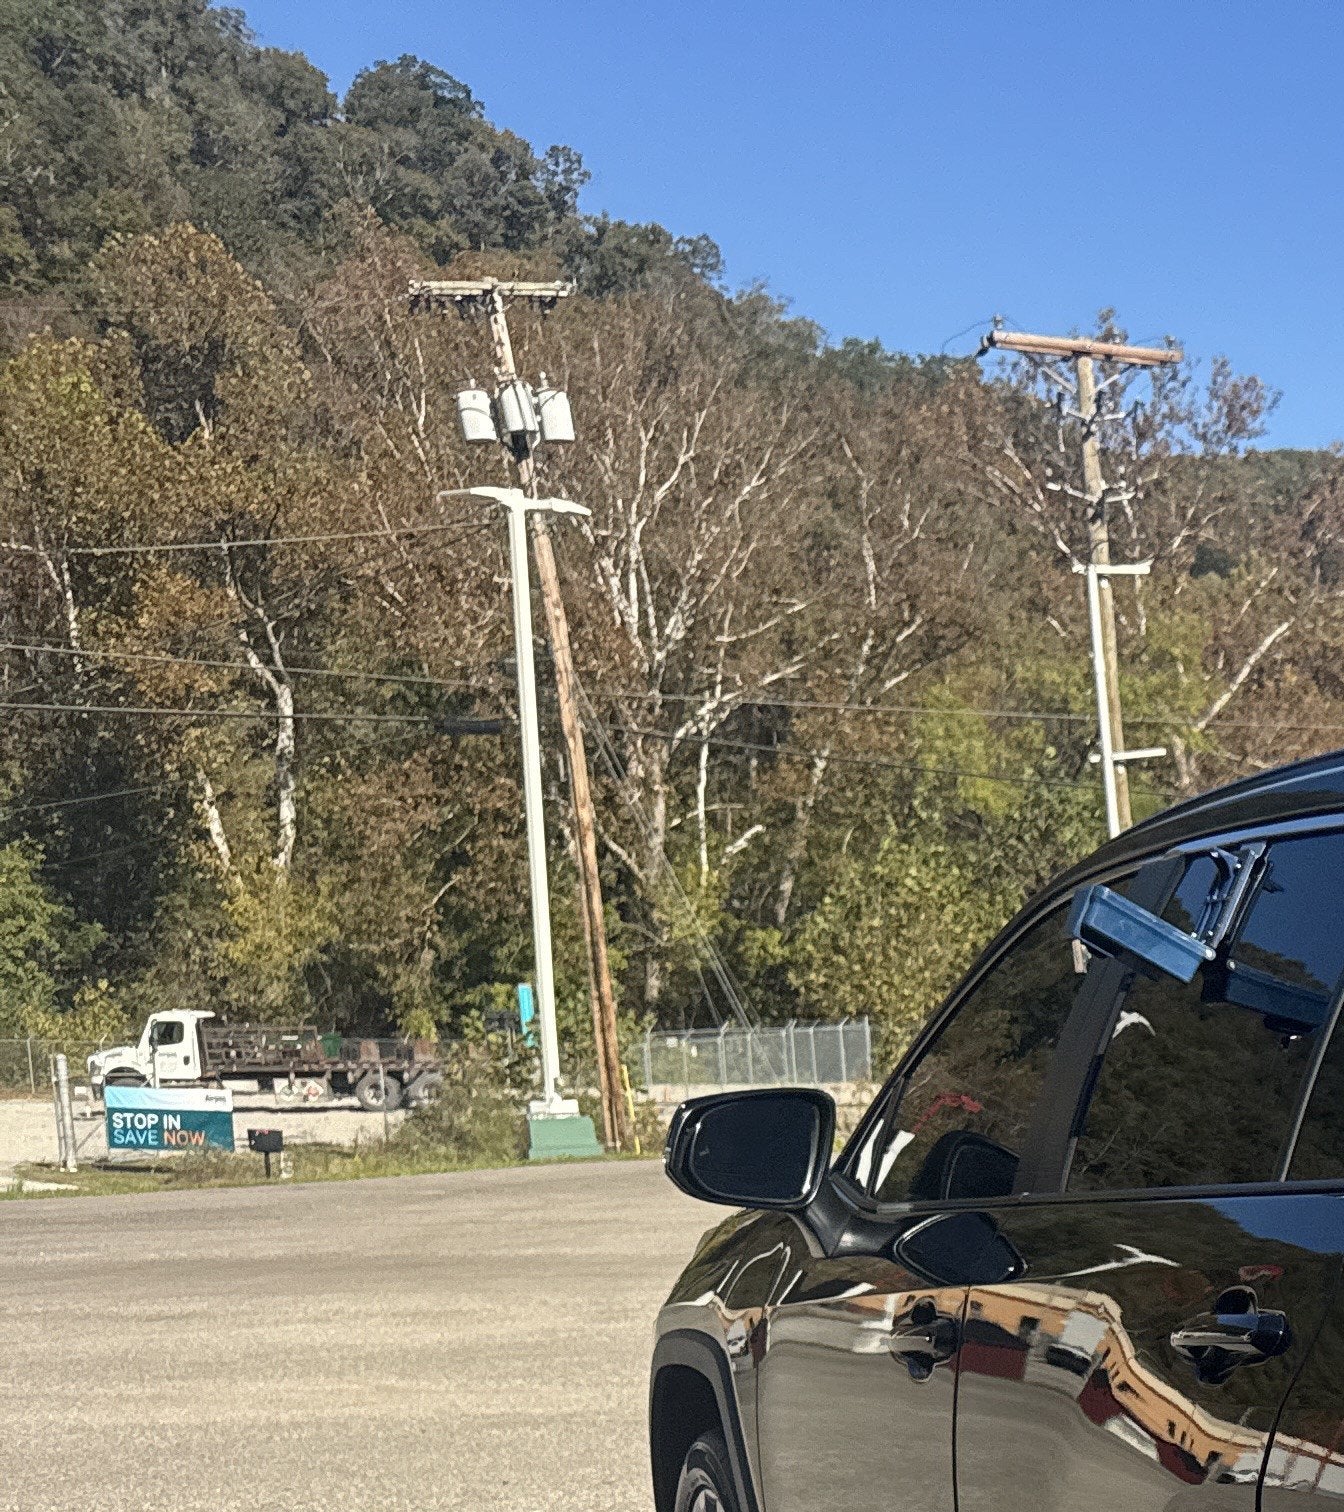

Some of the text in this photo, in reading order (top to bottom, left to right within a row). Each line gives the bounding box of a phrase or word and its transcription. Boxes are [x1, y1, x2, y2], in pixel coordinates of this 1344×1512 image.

[112, 1112, 181, 1130] STOP IN
[113, 1128, 206, 1146] SAVE NOW
